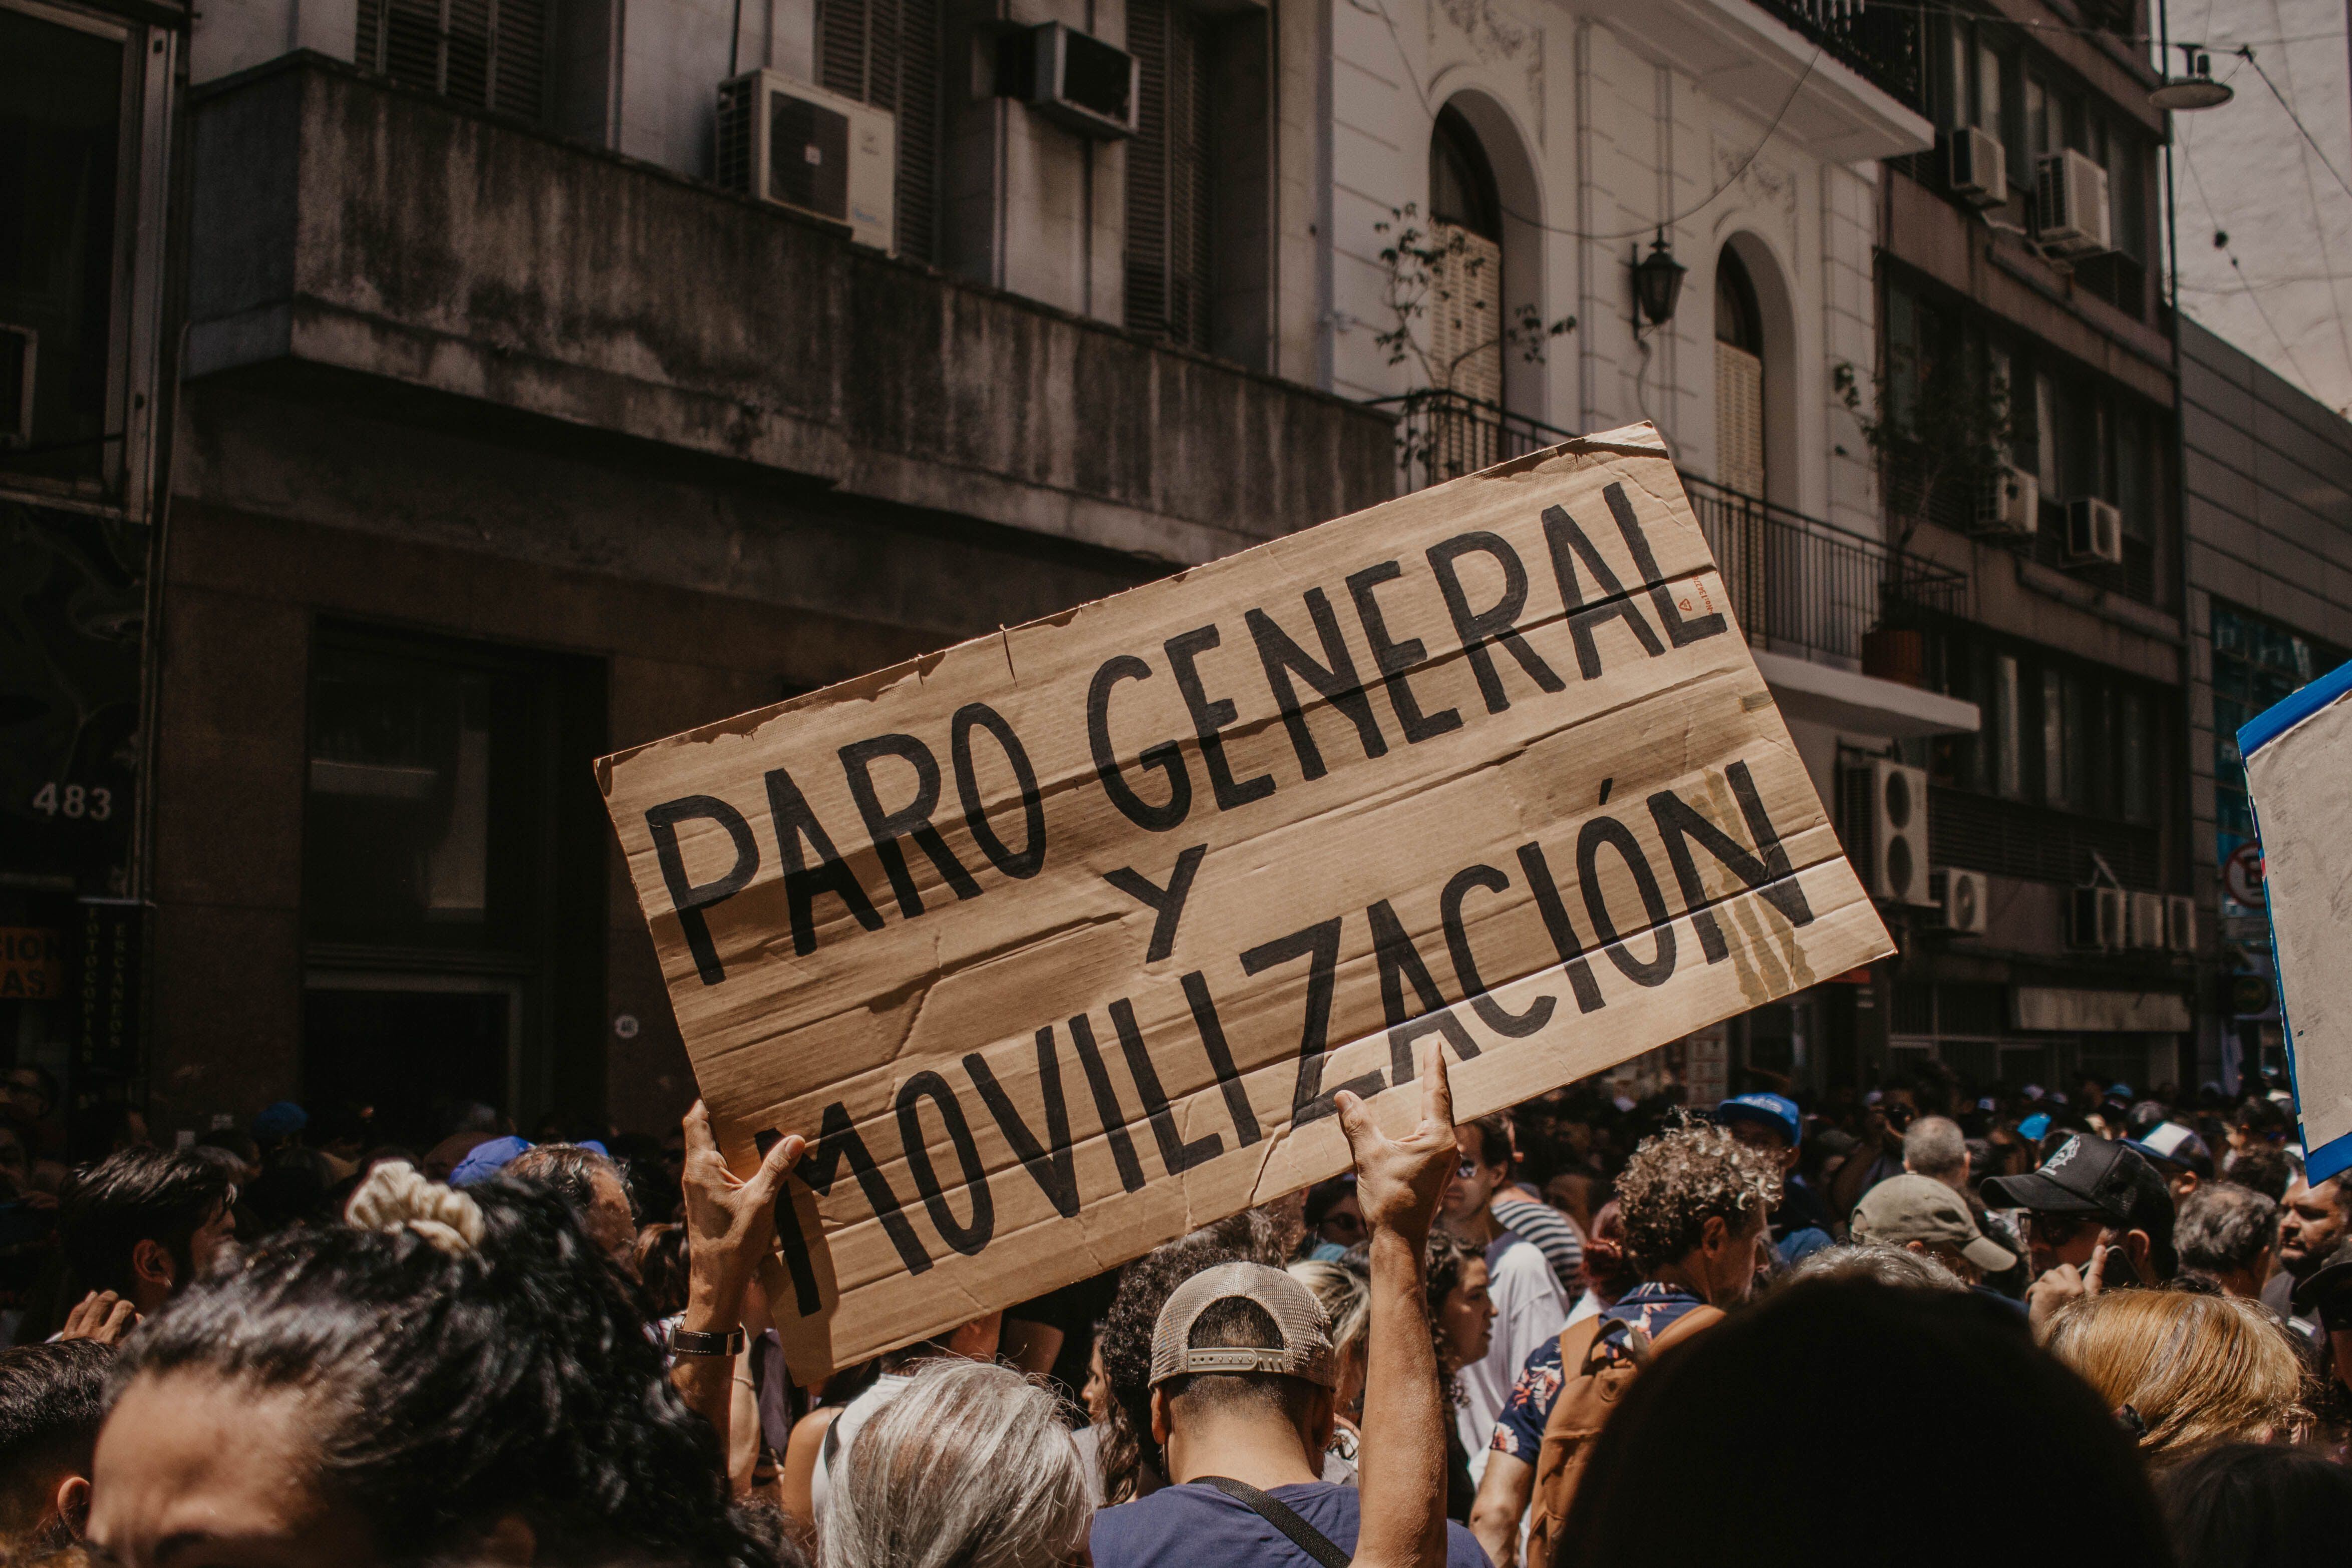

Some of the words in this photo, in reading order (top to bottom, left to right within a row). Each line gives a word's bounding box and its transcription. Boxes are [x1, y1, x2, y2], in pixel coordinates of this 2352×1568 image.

[32, 781, 112, 822] 483
[645, 702, 1046, 986] PARO
[1087, 482, 1727, 832] GENERAL
[755, 760, 1813, 1316] MOVILIZACIÓN
[1103, 843, 1208, 964] Y
